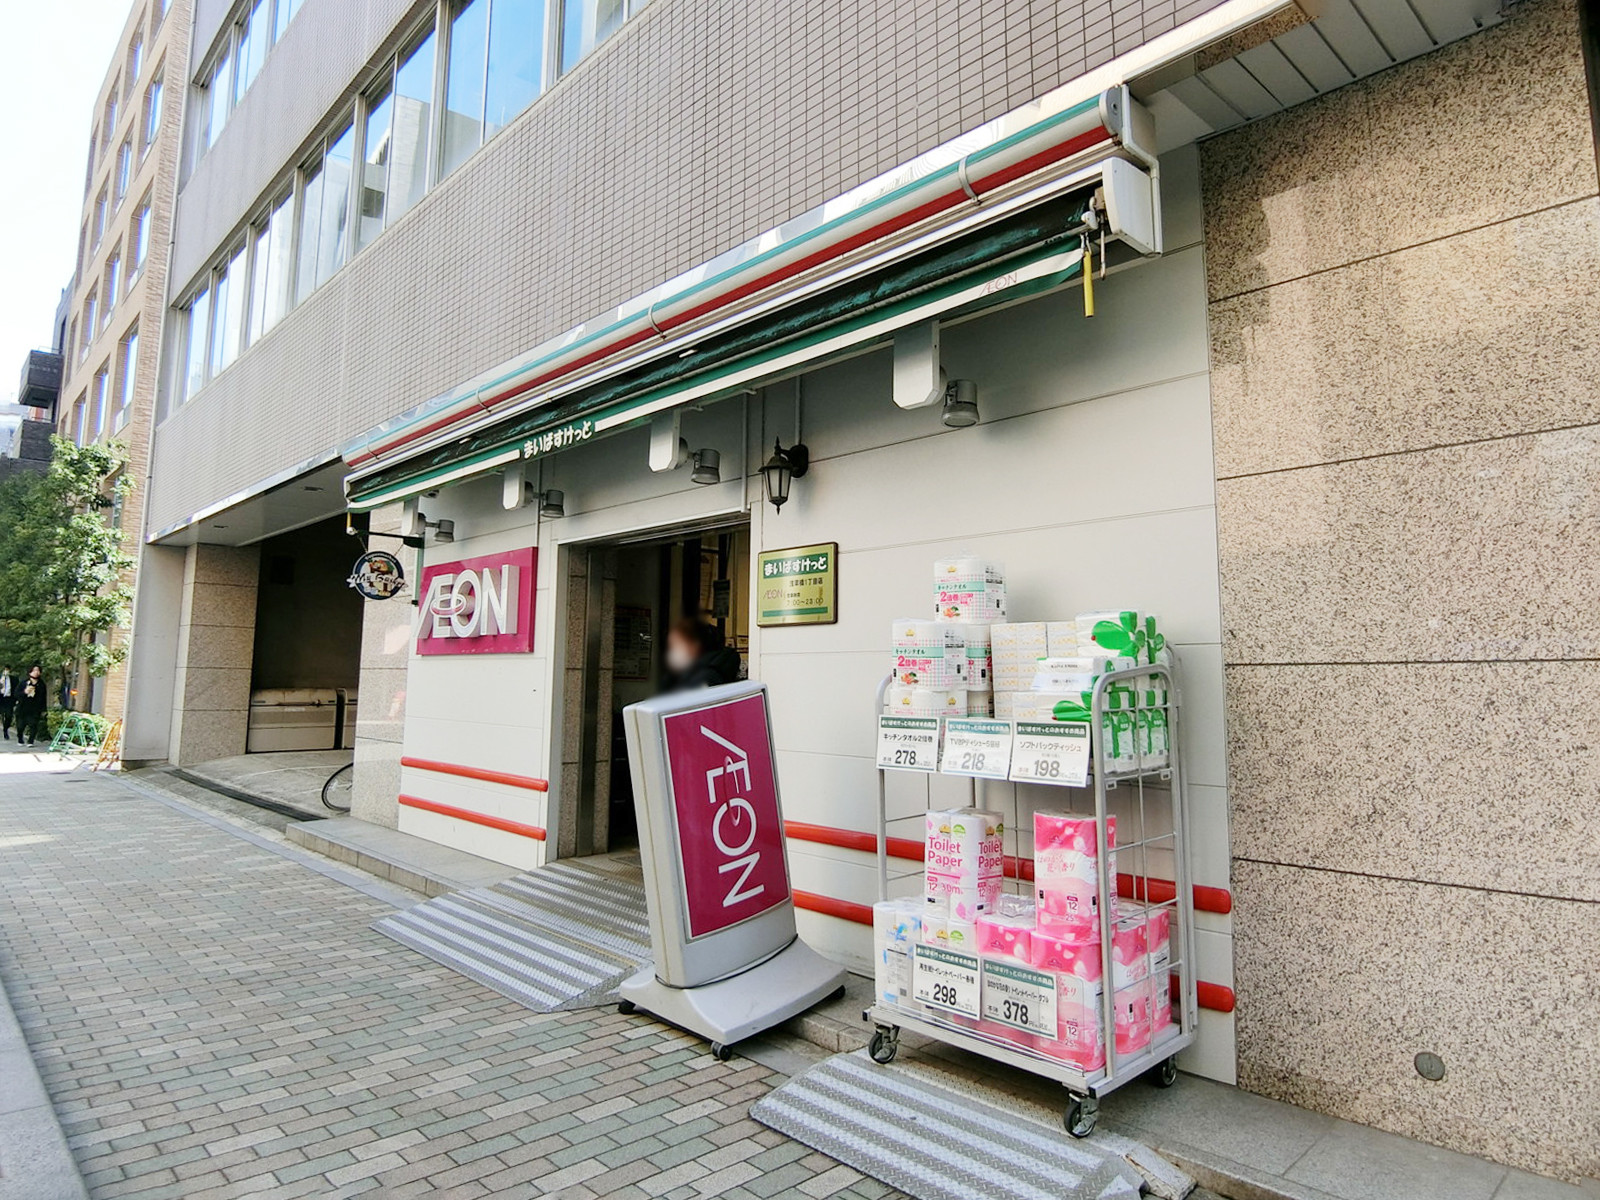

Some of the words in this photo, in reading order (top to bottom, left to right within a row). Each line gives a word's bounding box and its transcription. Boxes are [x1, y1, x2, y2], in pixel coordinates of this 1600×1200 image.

[523, 420, 592, 459] まいばすけっと
[764, 556, 827, 577] まいばすけっと
[895, 749, 917, 766] 278
[961, 752, 986, 771] 218
[1034, 759, 1060, 778] 198
[928, 836, 961, 854] Toilet
[928, 850, 963, 868] Paper
[928, 882, 938, 891] 12
[1068, 901, 1078, 911] 12
[933, 982, 957, 1006] 298
[1003, 999, 1029, 1025] 378
[1067, 1026, 1077, 1036] 12
